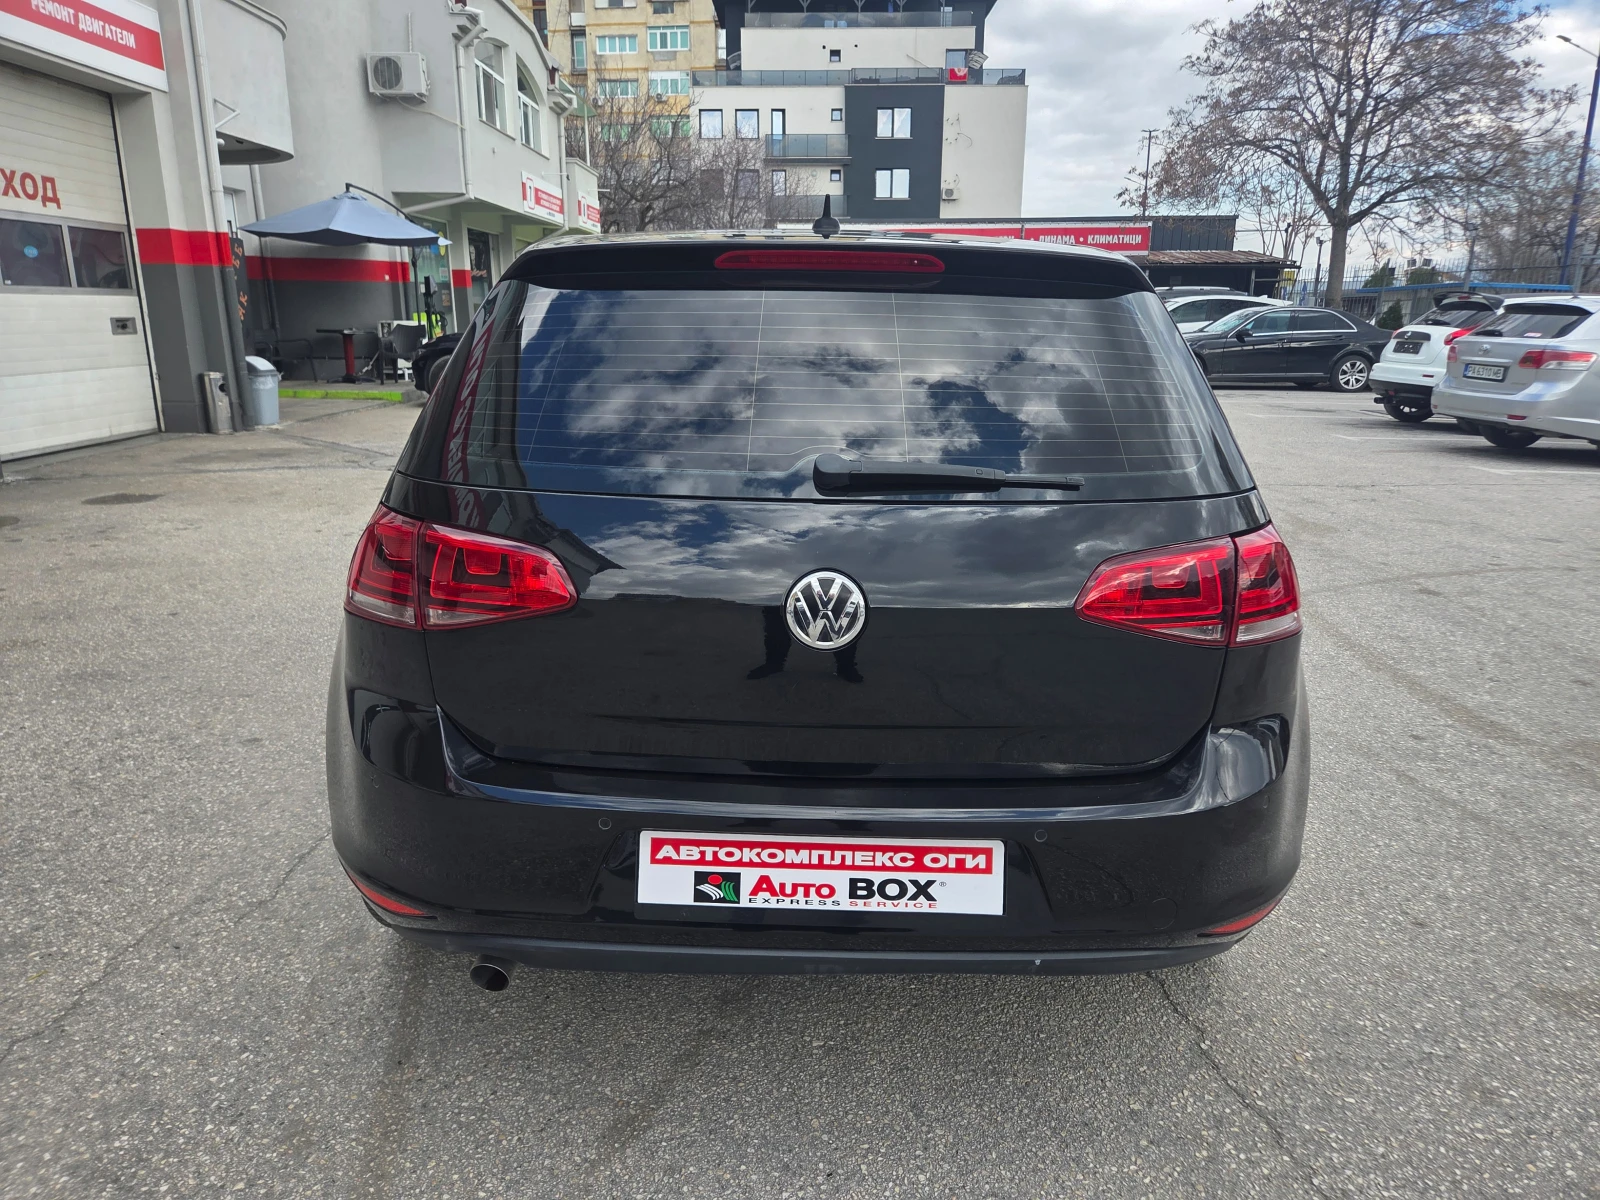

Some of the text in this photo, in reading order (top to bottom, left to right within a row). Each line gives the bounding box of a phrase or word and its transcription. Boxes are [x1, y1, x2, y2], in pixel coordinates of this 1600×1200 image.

[31, 0, 136, 49] РЕМОНТ ДВИГАТЕЛИ
[0, 168, 62, 210] ХОД
[1087, 234, 1142, 244] КЛИМАТИЦИ
[655, 844, 987, 869] АВТОКОМПЛЕКС ОГИ
[849, 877, 937, 902] BOX
[749, 897, 938, 909] EXPRESS SERVICE
